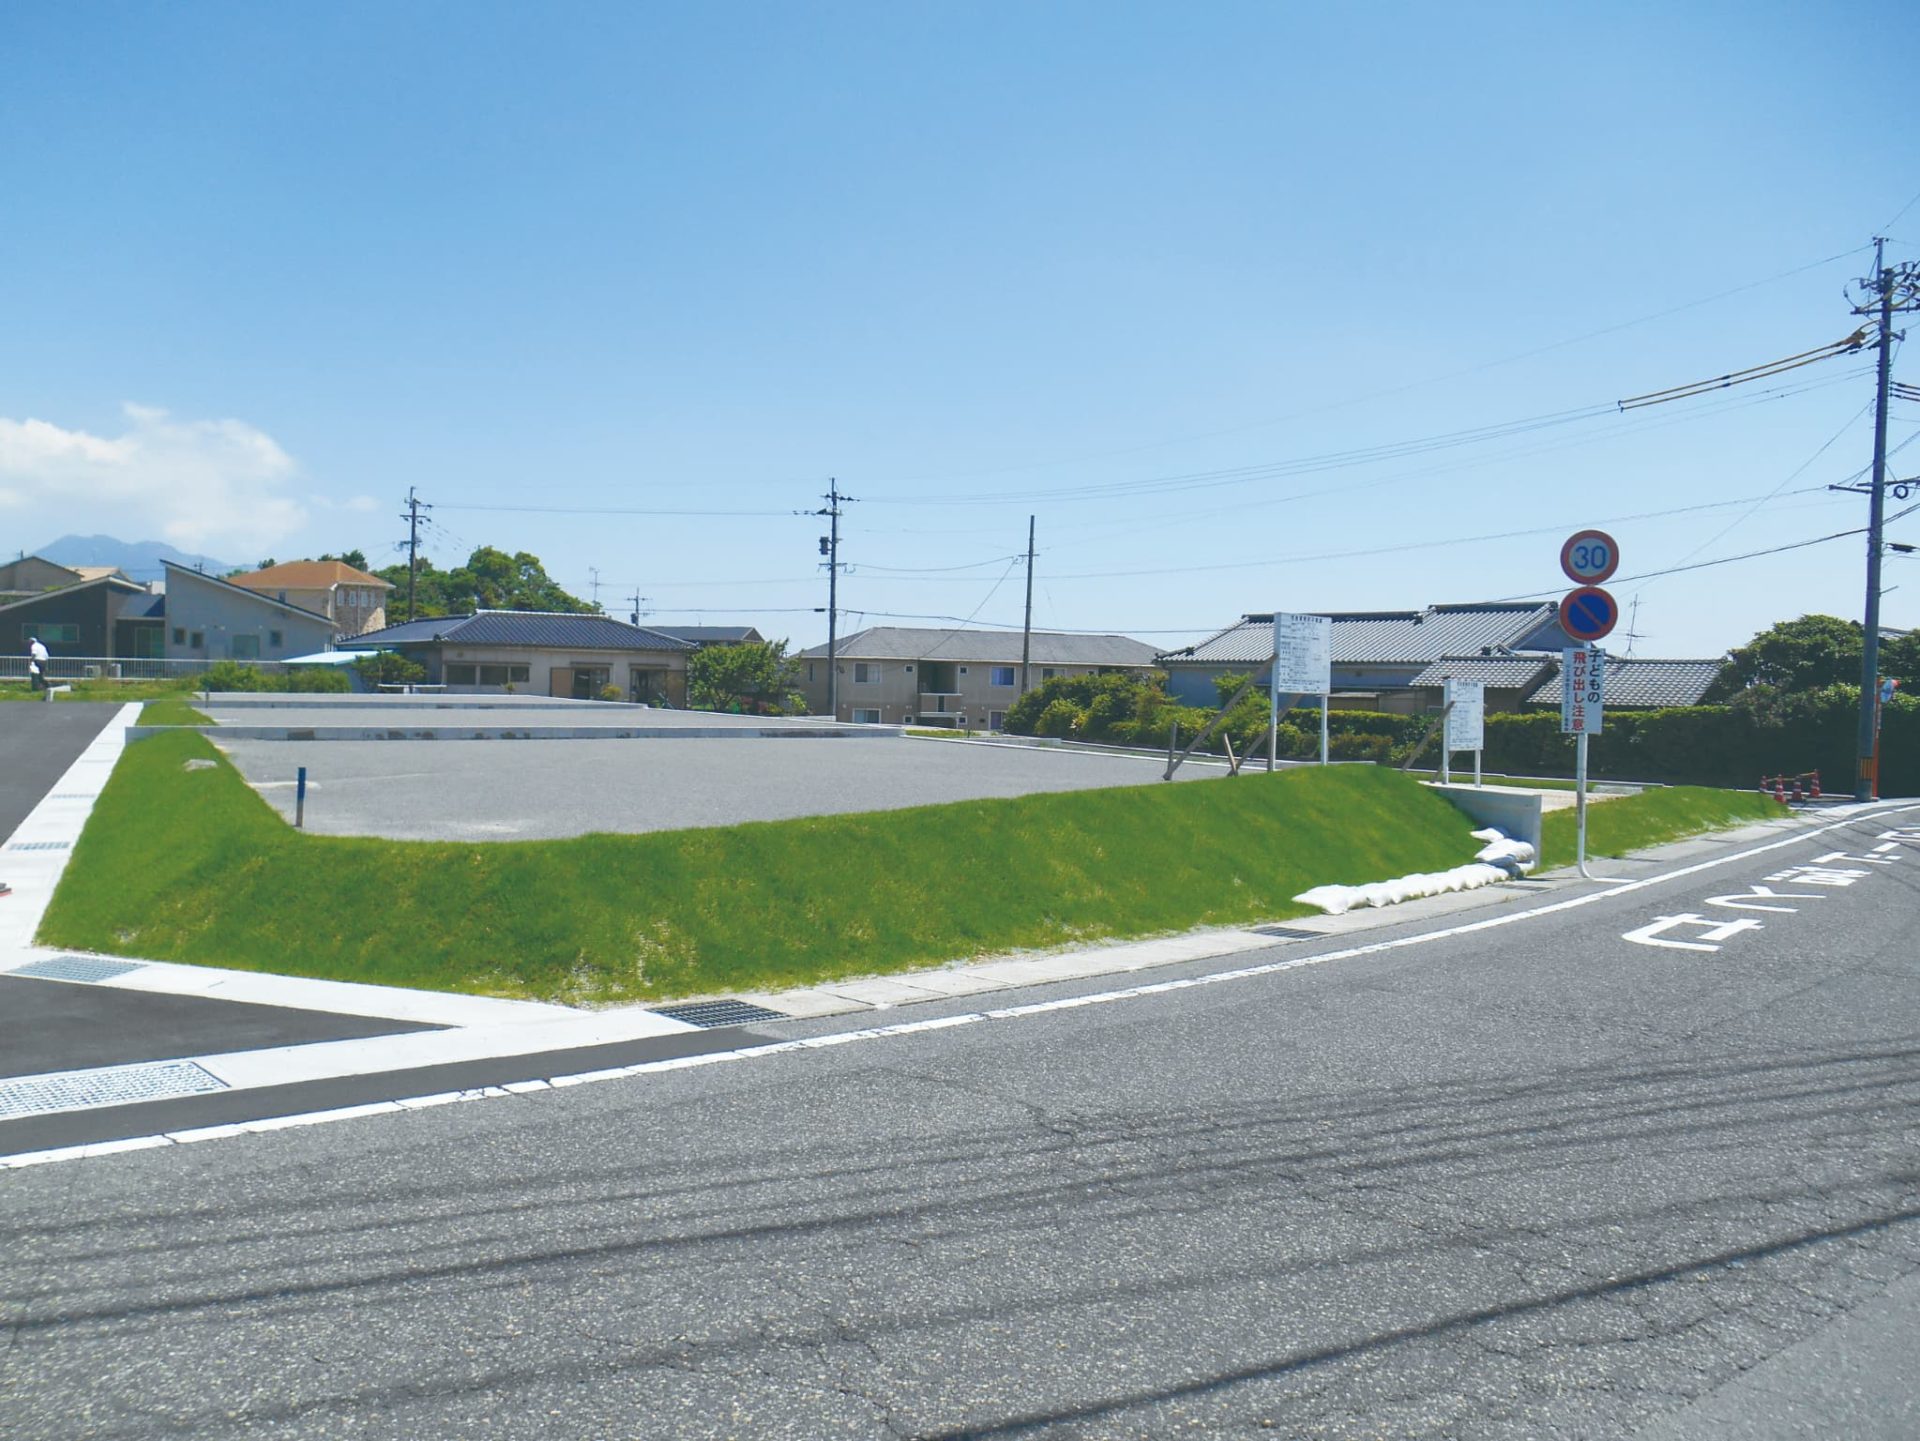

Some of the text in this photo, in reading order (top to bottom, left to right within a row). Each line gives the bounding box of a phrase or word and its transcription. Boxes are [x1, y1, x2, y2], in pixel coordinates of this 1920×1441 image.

[1574, 545, 1606, 570] 30
[1572, 651, 1586, 731] 飛び出し注意
[1587, 650, 1601, 703] 子どもの
